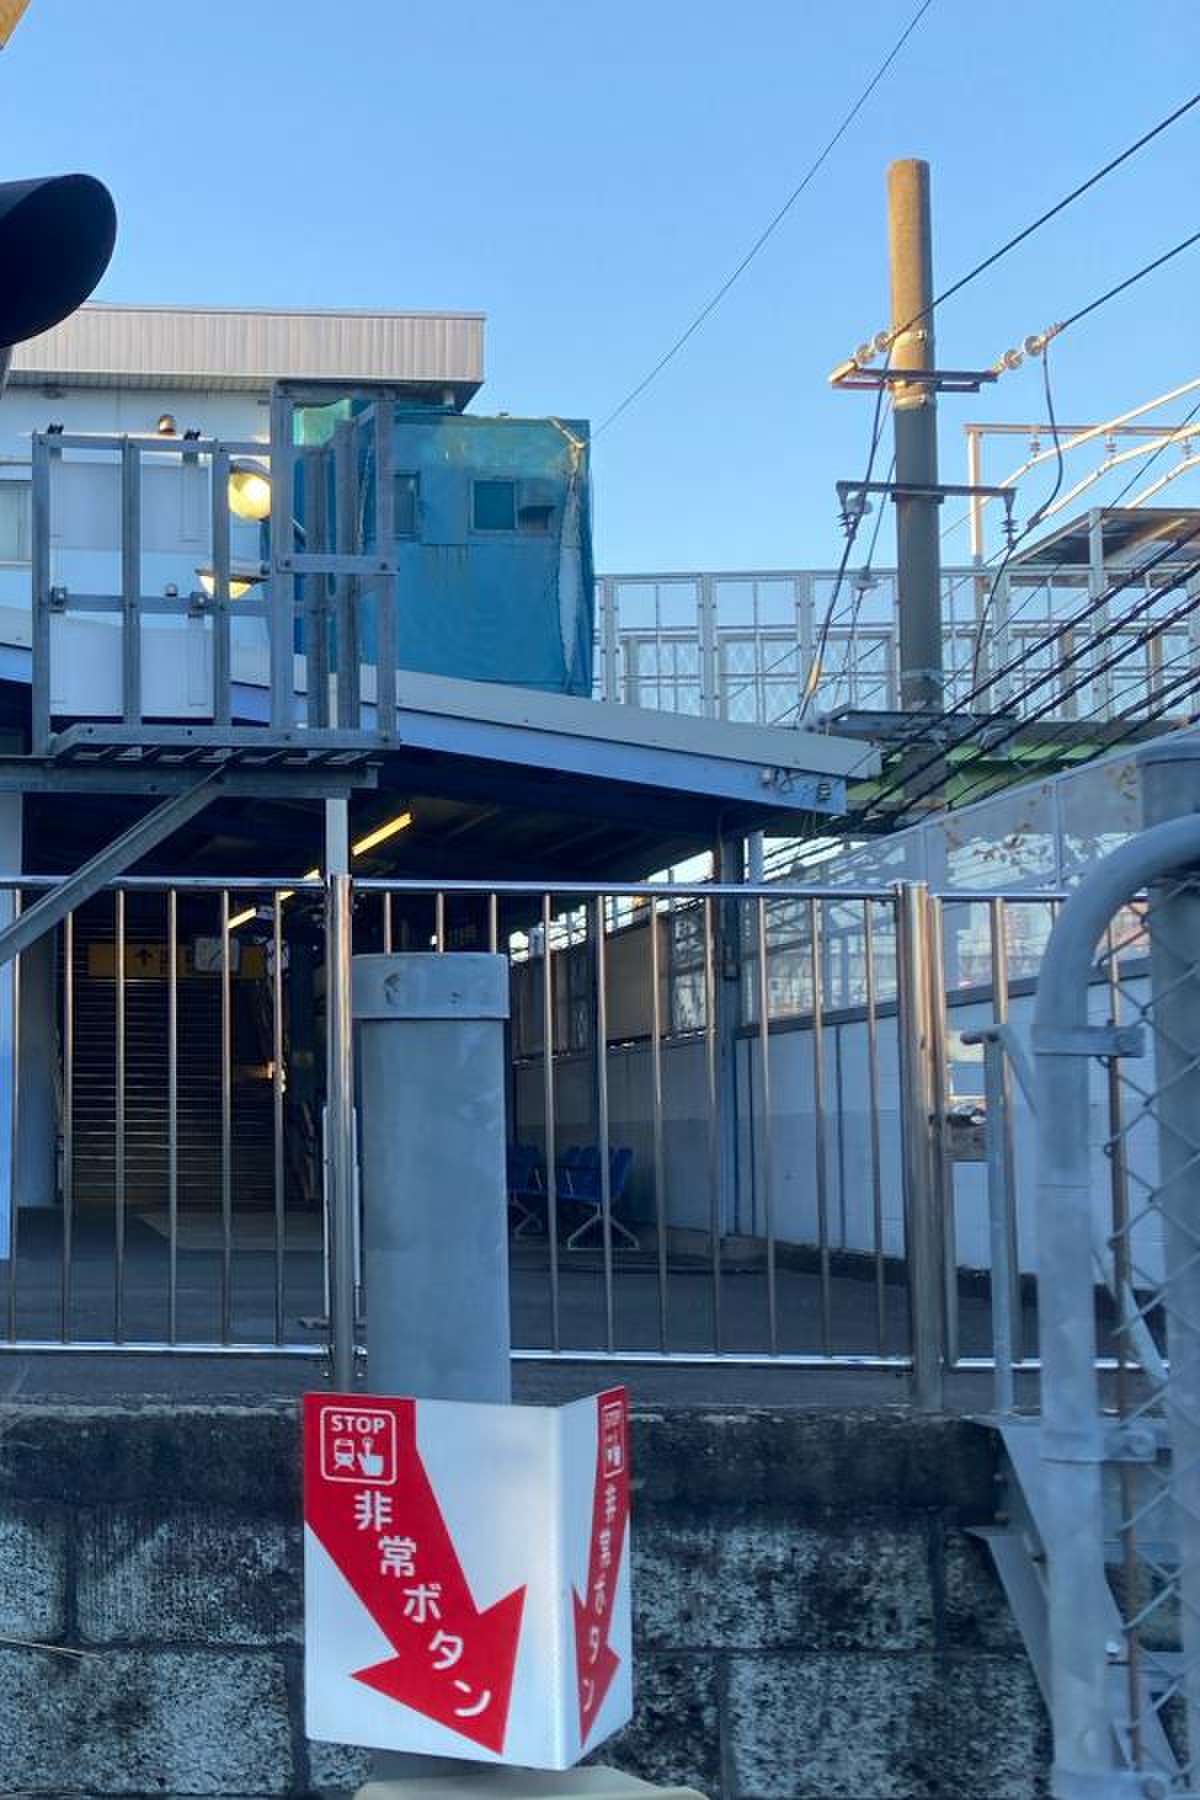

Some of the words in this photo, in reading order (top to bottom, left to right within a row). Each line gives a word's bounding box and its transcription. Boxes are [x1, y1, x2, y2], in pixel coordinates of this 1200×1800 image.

[330, 1415, 386, 1434] STOP
[353, 1491, 492, 1717] 非常ボタン
